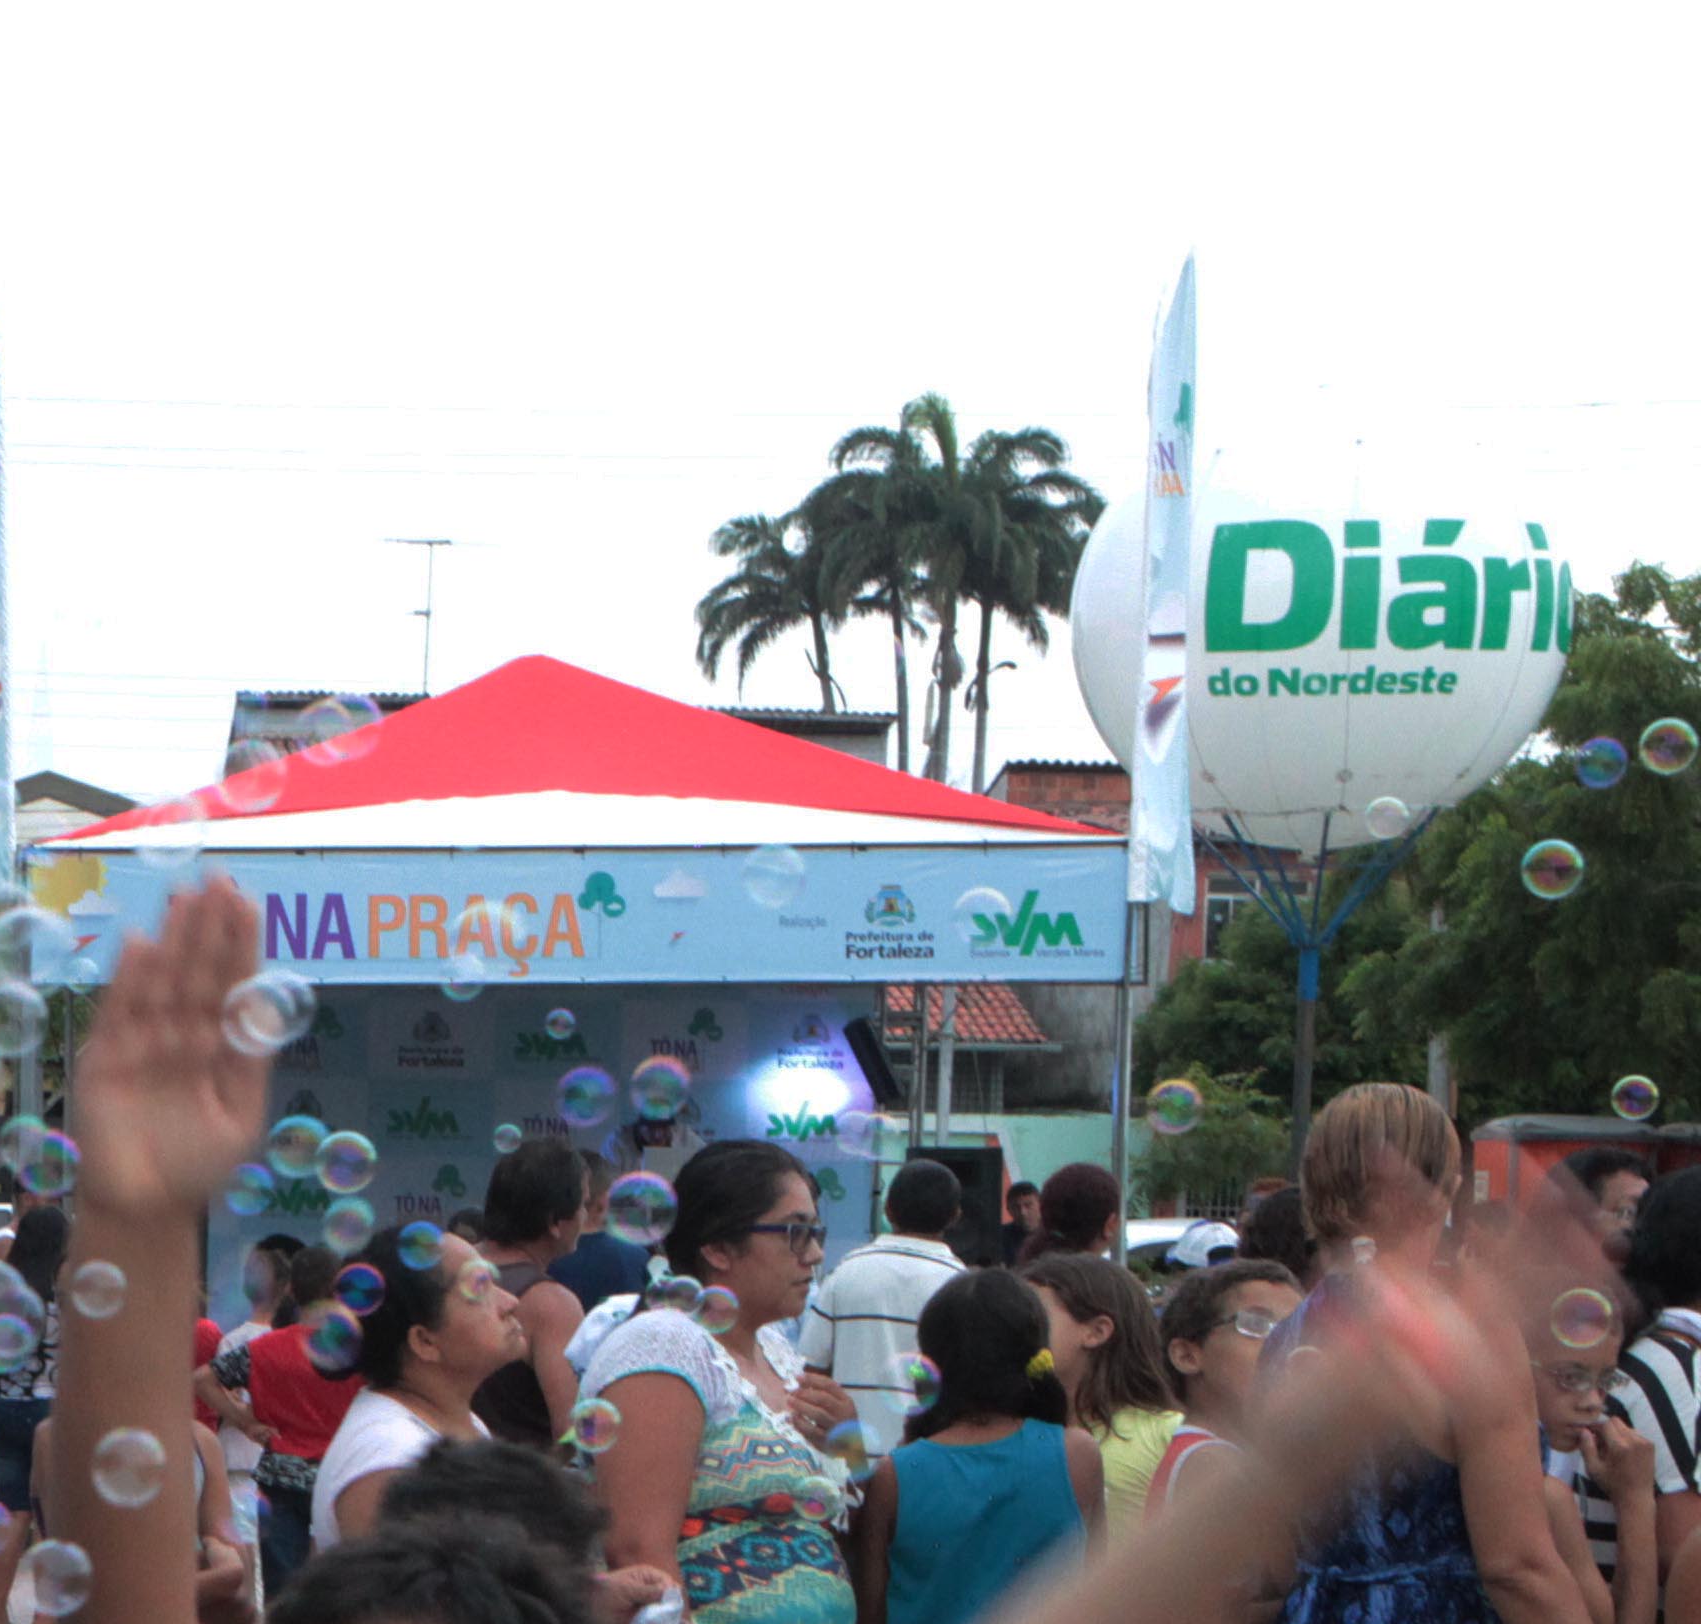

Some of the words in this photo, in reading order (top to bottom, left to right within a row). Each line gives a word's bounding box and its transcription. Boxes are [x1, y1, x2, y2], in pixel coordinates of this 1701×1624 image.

[1207, 668, 1259, 697] do
[1267, 664, 1458, 697] Nordeste
[265, 892, 357, 960] NA
[367, 892, 585, 977] PRAÇA
[845, 930, 914, 942] Prefeitura
[917, 930, 935, 942] de
[845, 942, 935, 960] Fortaleza
